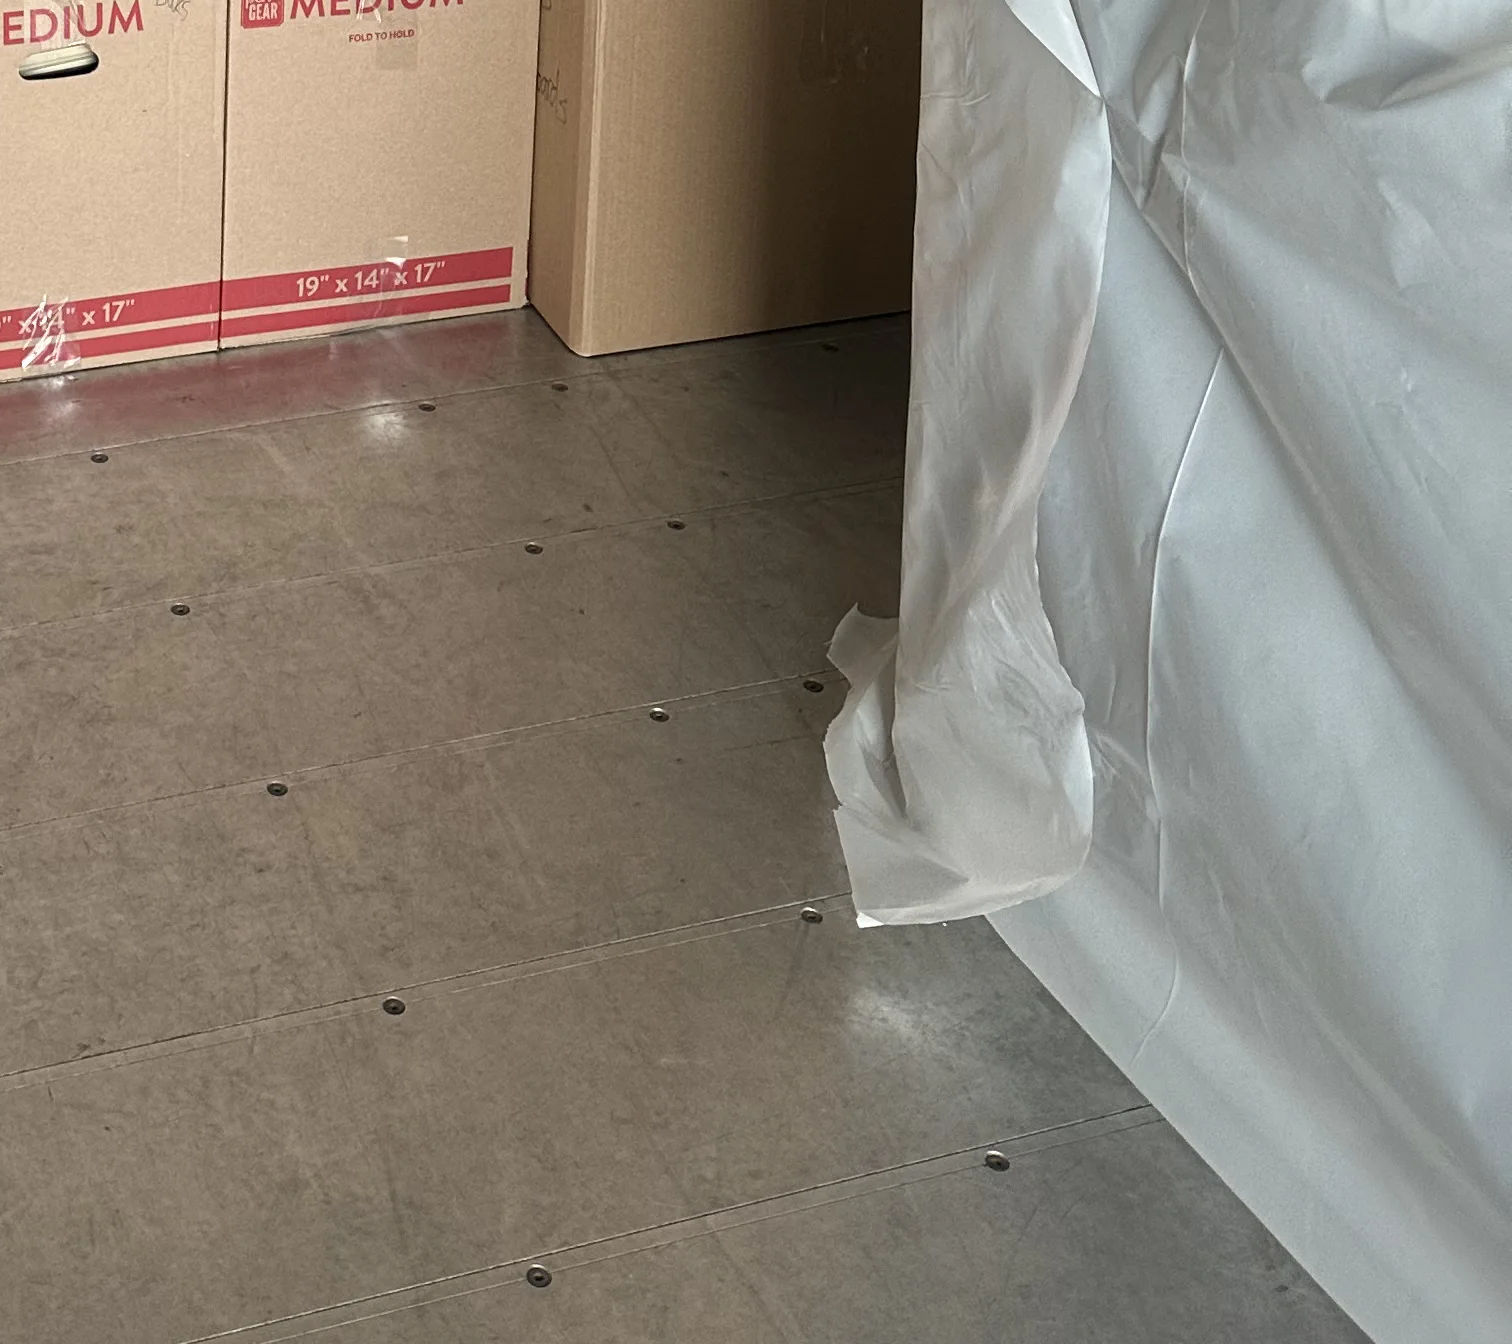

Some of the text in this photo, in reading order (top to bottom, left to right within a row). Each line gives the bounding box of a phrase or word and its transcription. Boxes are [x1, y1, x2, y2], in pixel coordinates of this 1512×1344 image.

[248, 3, 279, 21] GEAR
[348, 29, 415, 43] FOLD TO HOLD
[296, 261, 446, 297] 19" x 14" x 17"
[18, 319, 32, 335] x
[82, 310, 96, 326] x
[103, 298, 135, 323] 17"
